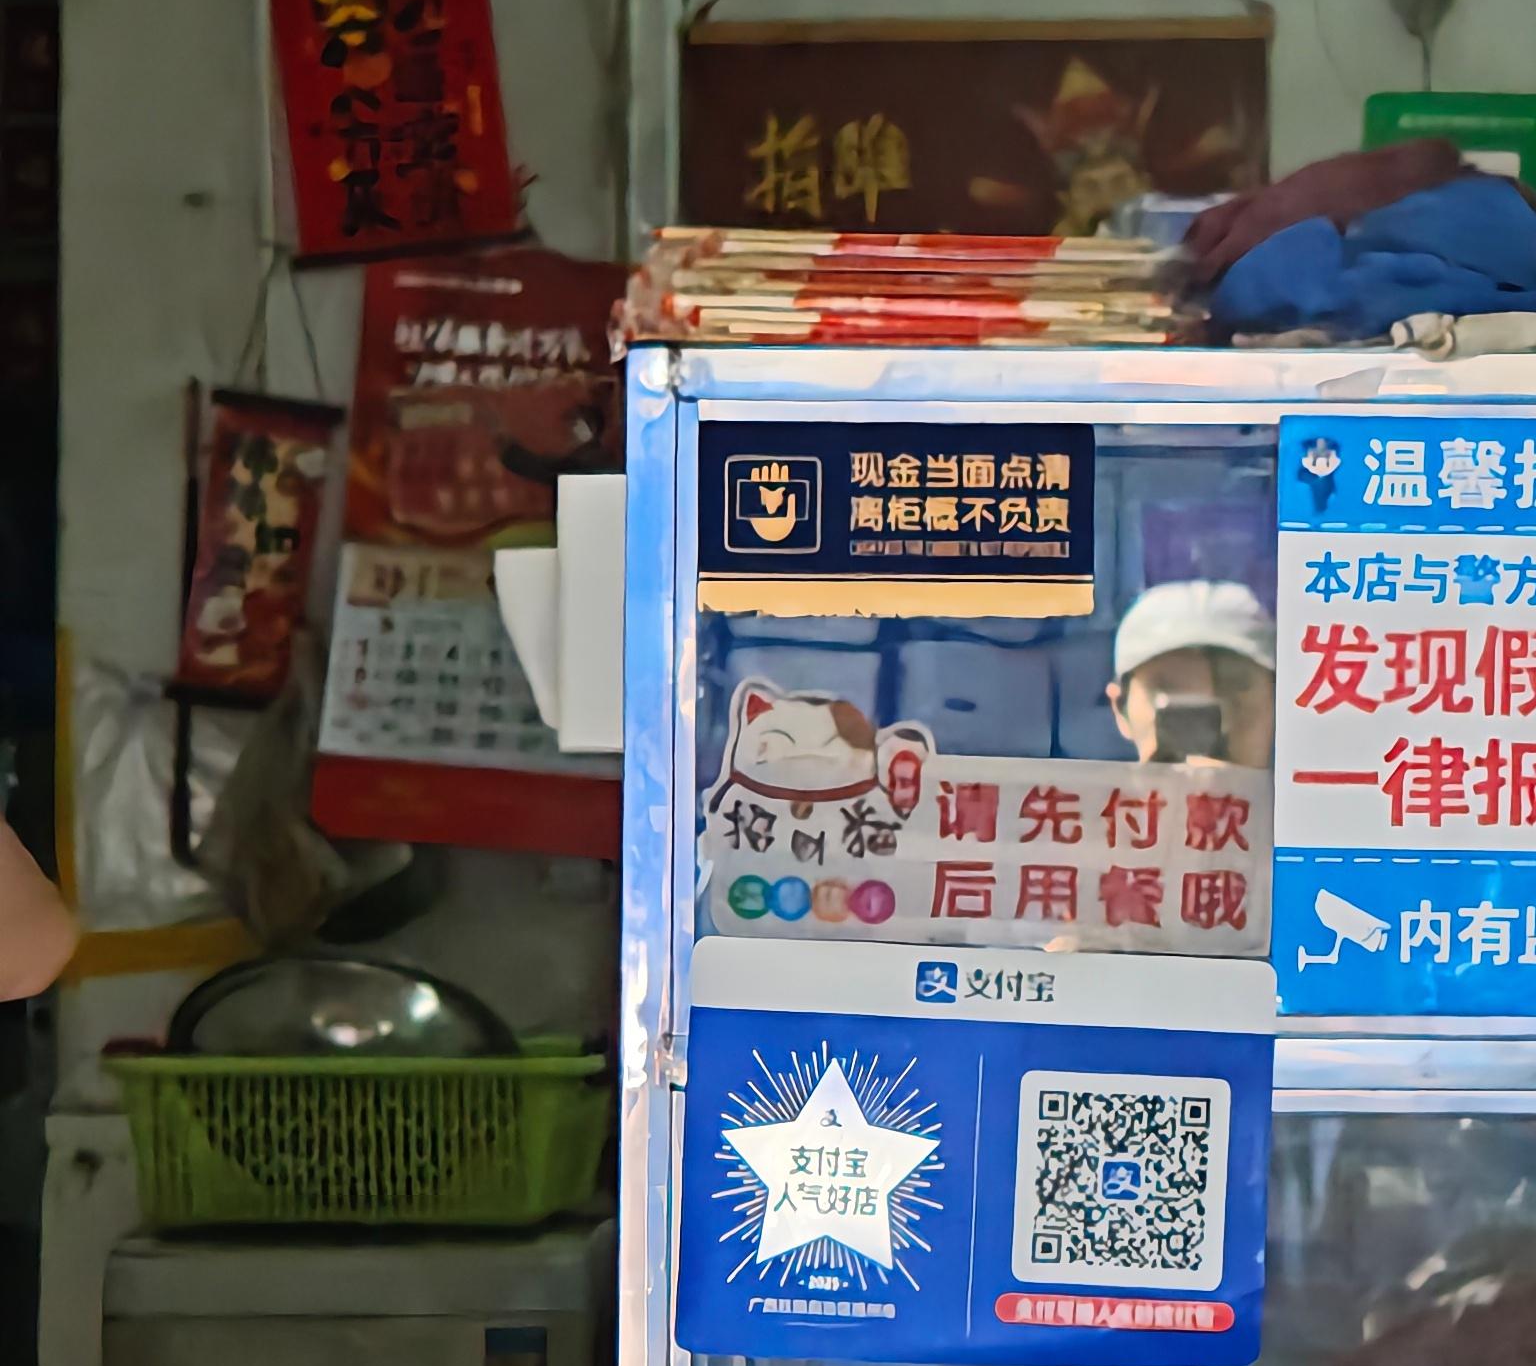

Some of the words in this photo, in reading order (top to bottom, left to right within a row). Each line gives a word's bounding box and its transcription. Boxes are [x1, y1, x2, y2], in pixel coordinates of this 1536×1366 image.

[850, 452, 1070, 490] 现金当面点清
[935, 780, 1252, 852] 请先付款
[930, 860, 1248, 930] 后用餐哦
[965, 968, 1056, 1004] 支付宝
[789, 1146, 869, 1177] 支付宝
[773, 1182, 880, 1216] 人气好店
